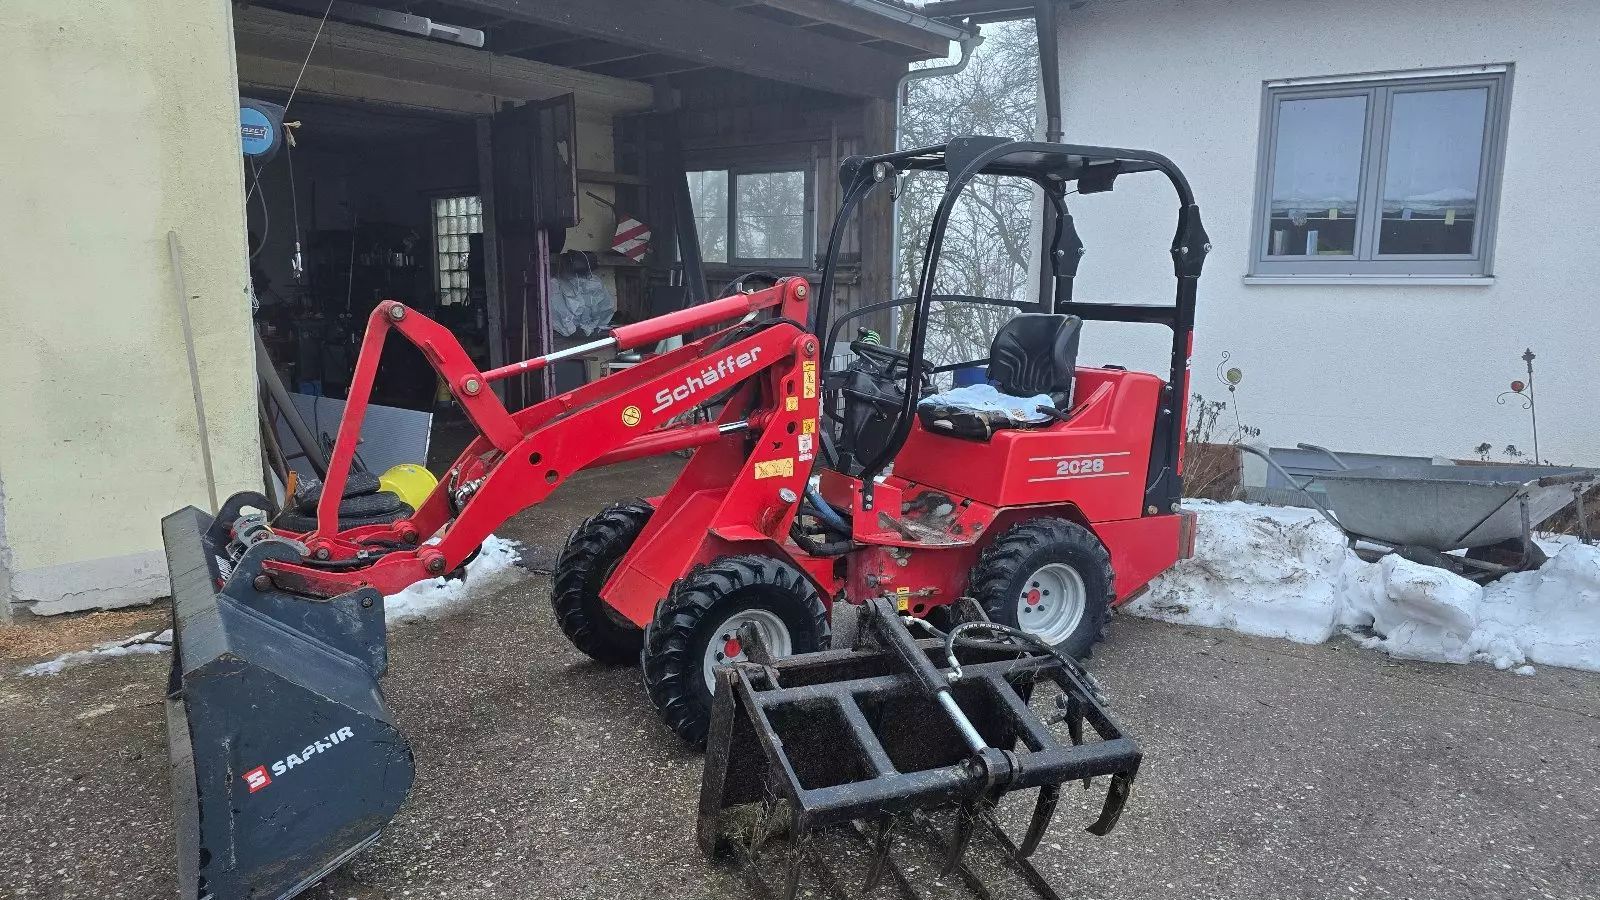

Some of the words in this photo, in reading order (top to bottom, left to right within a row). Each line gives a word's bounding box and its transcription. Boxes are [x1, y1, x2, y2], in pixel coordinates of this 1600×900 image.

[652, 346, 762, 414] Schäffer
[1056, 458, 1104, 475] 2028
[271, 726, 355, 777] SAPHIR
